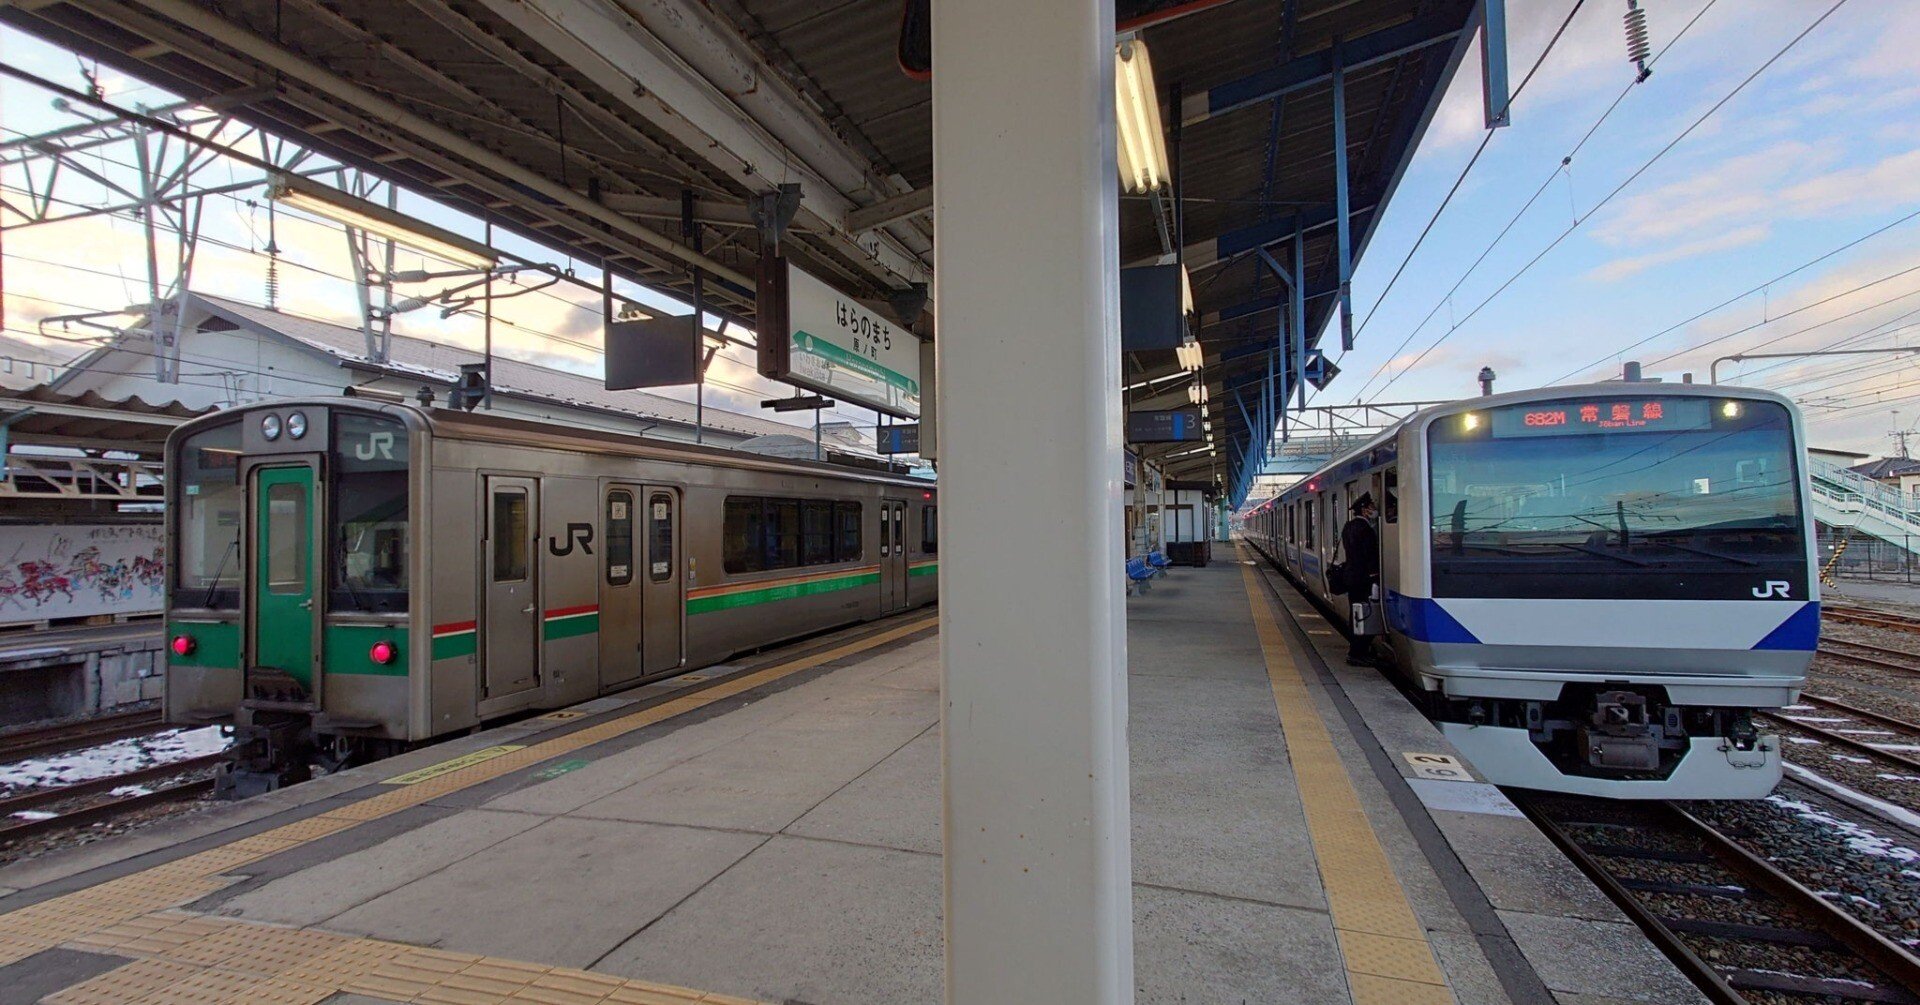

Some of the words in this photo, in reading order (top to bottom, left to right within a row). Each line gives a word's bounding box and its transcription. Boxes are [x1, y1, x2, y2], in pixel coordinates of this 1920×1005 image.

[836, 300, 892, 351] はらのまち
[852, 337, 878, 361] 原ノ町
[1186, 414, 1195, 429] 3
[1525, 411, 1566, 425] 682M
[355, 431, 394, 461] JR
[549, 522, 594, 557] JR
[1752, 580, 1790, 598] JR
